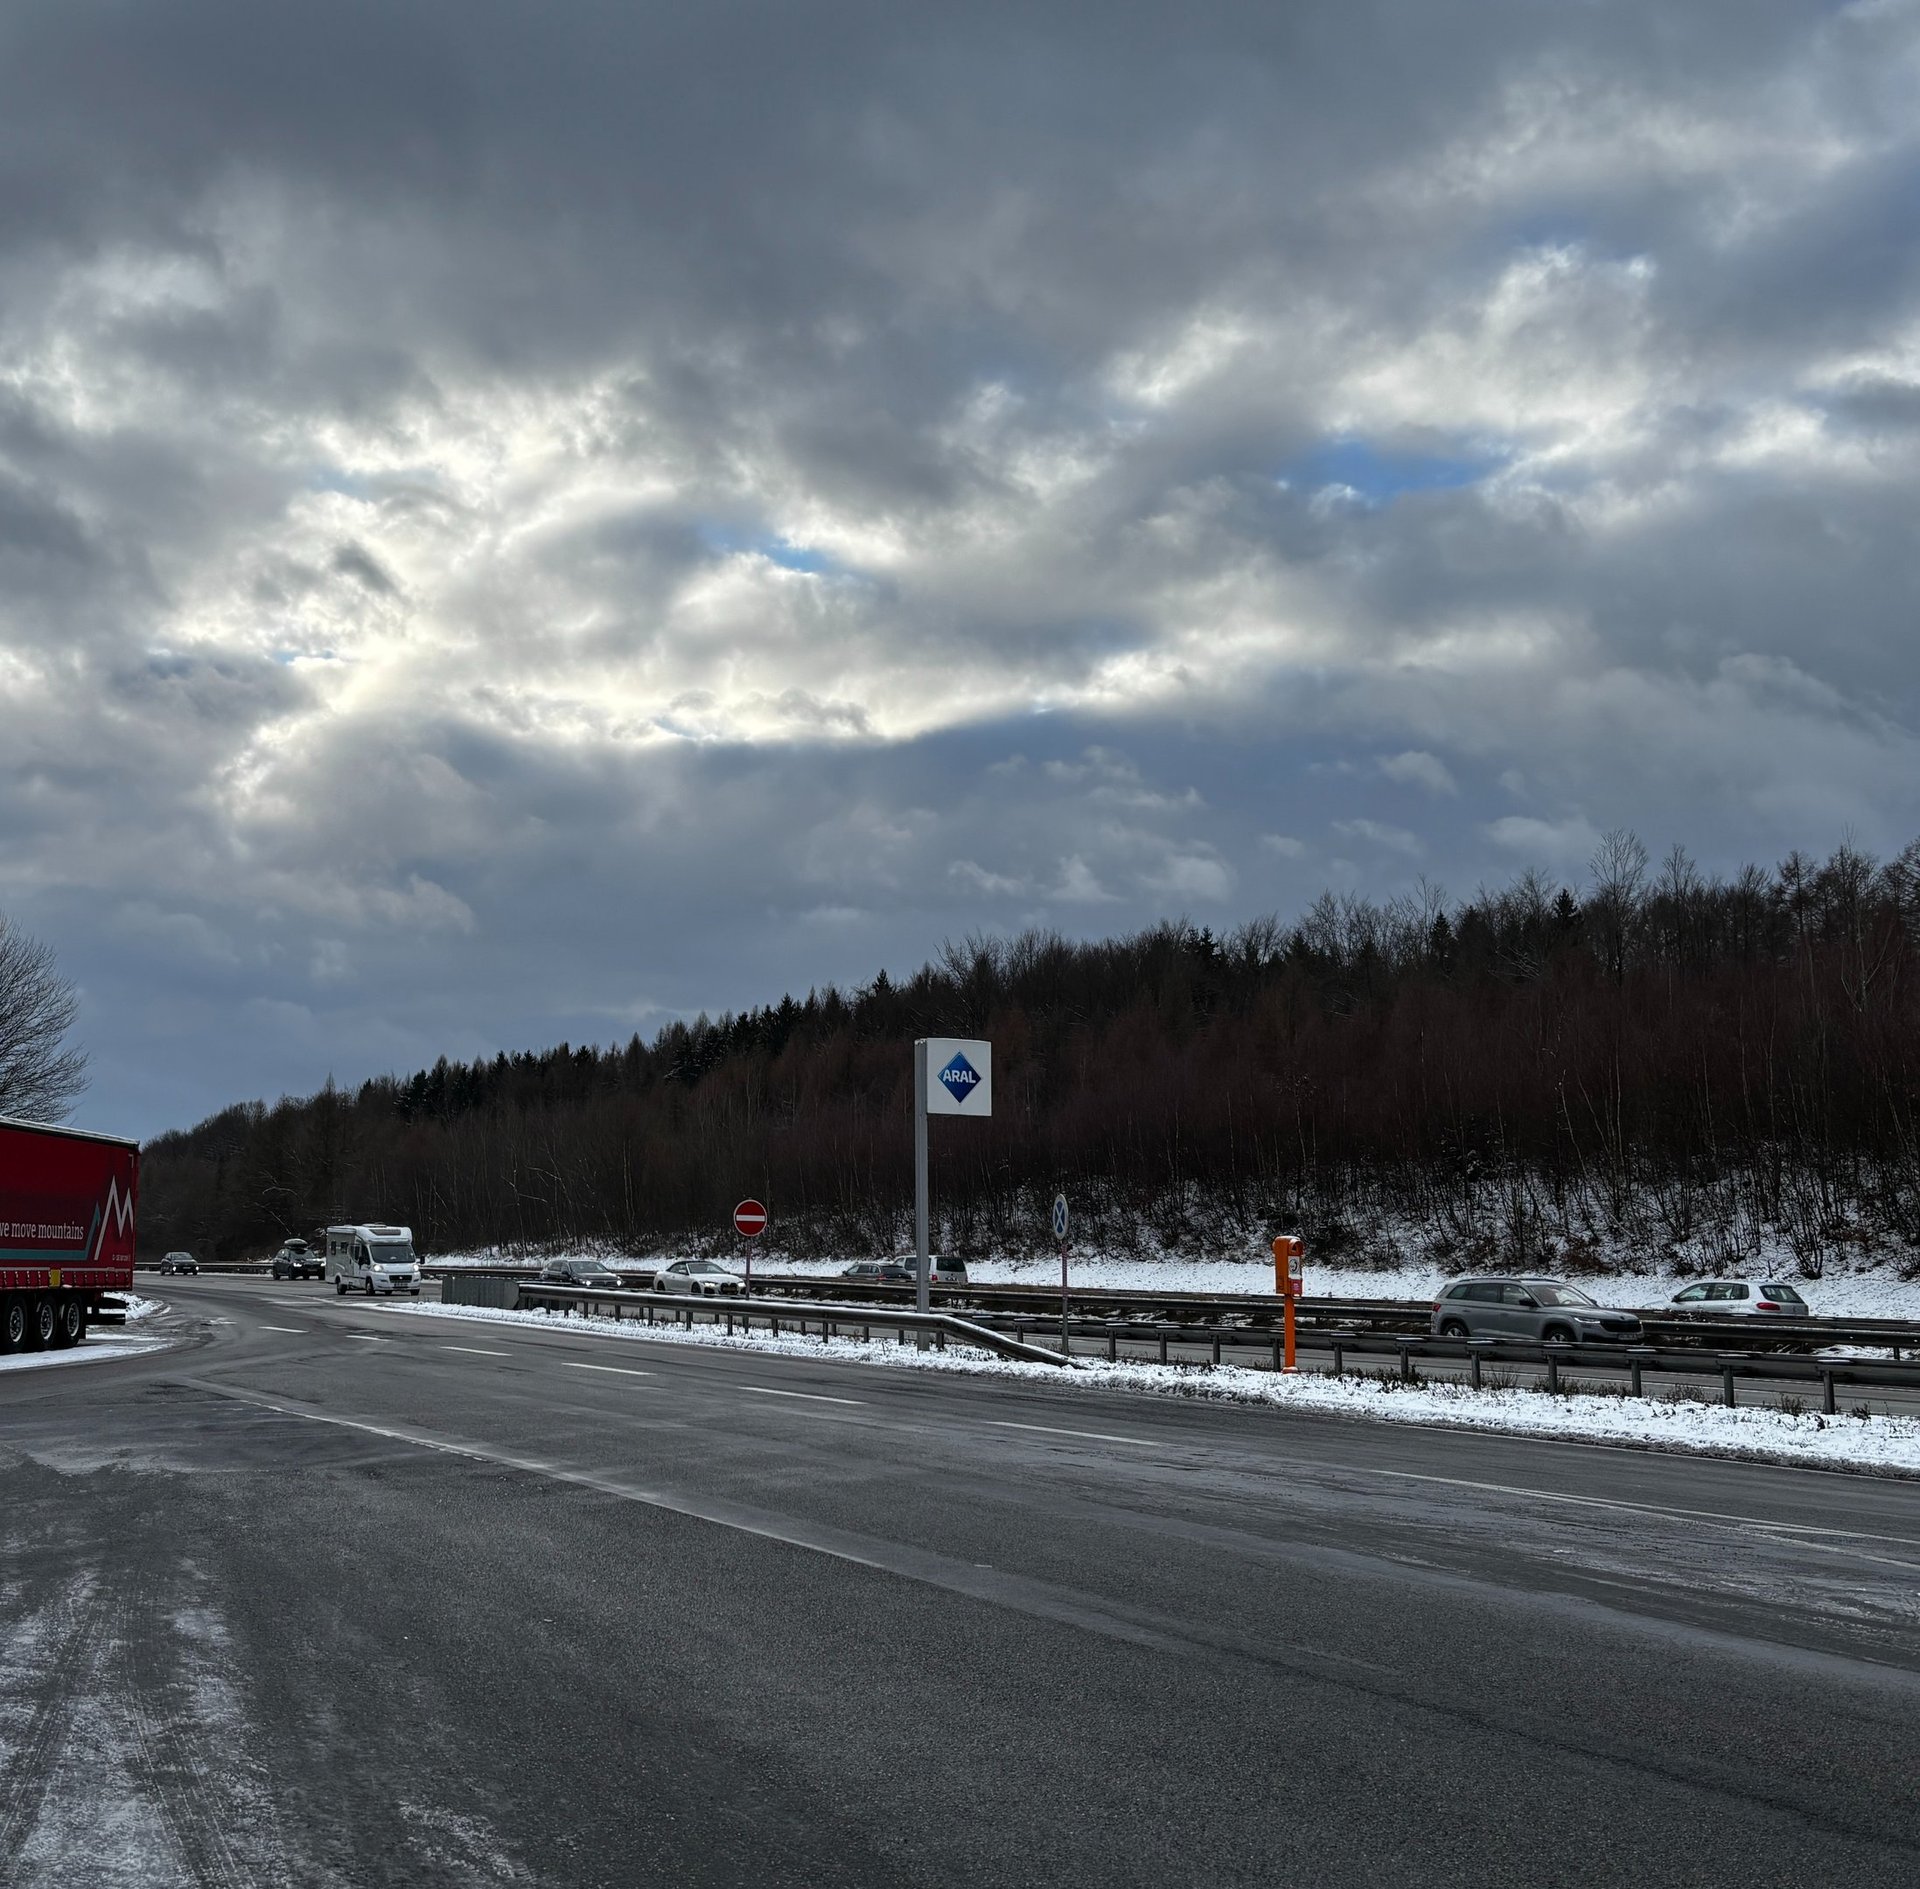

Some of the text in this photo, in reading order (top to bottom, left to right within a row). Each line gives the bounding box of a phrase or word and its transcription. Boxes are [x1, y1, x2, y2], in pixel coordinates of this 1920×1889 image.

[943, 1069, 976, 1084] ARAL
[11, 1223, 36, 1238] move
[37, 1221, 84, 1240] mountains
